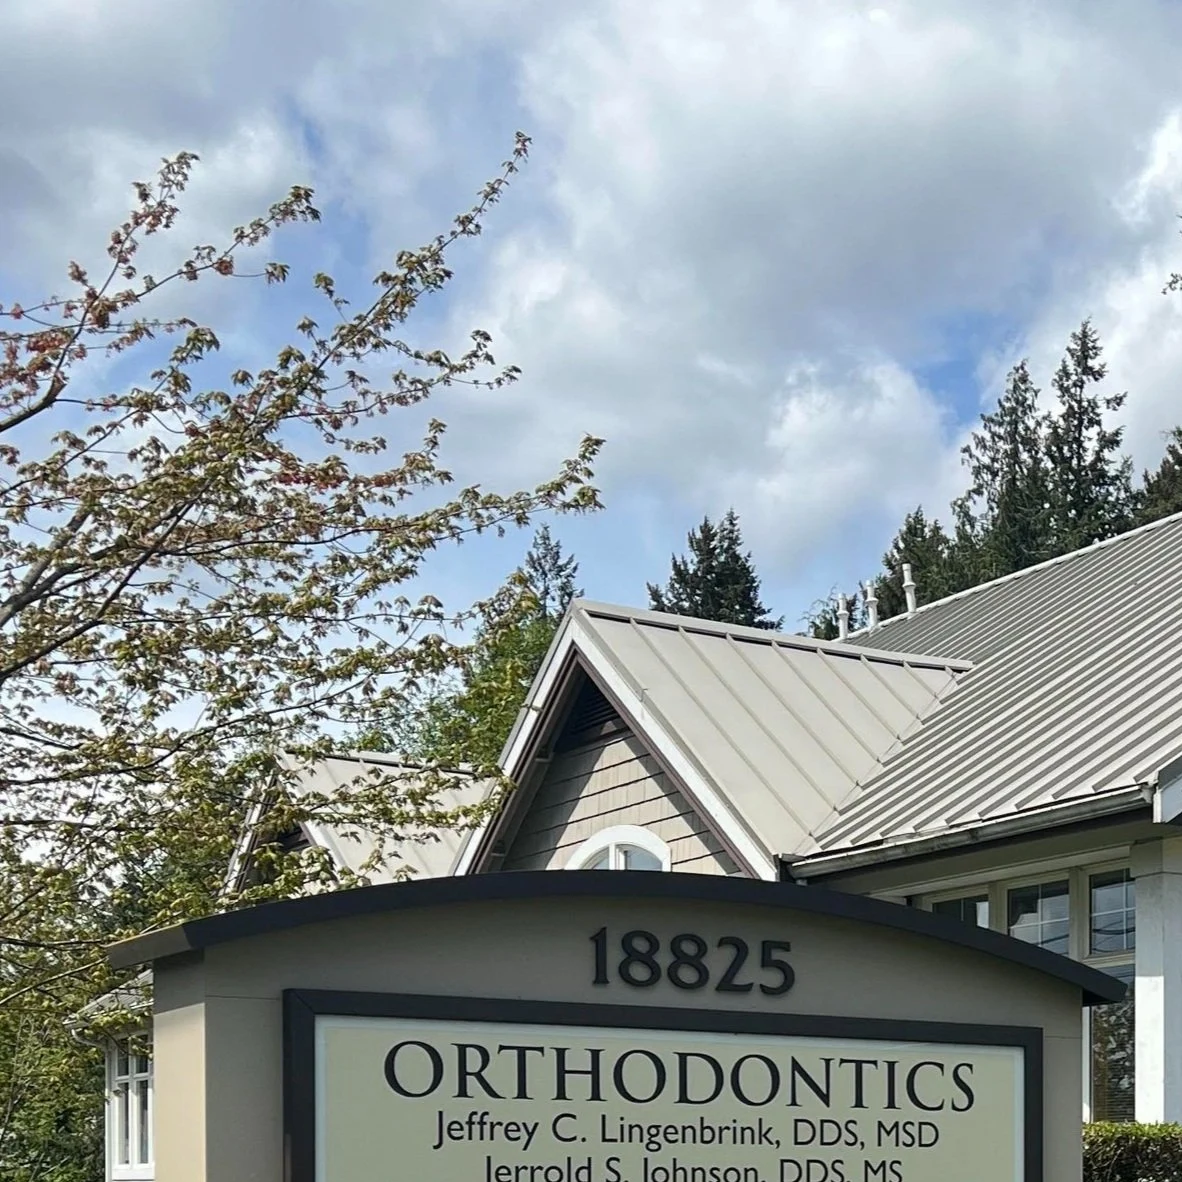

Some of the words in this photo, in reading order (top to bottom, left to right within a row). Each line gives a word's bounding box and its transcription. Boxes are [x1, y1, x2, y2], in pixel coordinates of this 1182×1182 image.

[589, 926, 797, 996] 18825
[383, 1039, 975, 1114] ORTHODONTICS
[432, 1110, 540, 1151] Jeffrey
[551, 1114, 586, 1144] C.
[601, 1114, 781, 1153] Lingenbrink,
[793, 1118, 865, 1150] DDS,
[877, 1120, 939, 1148] MSD
